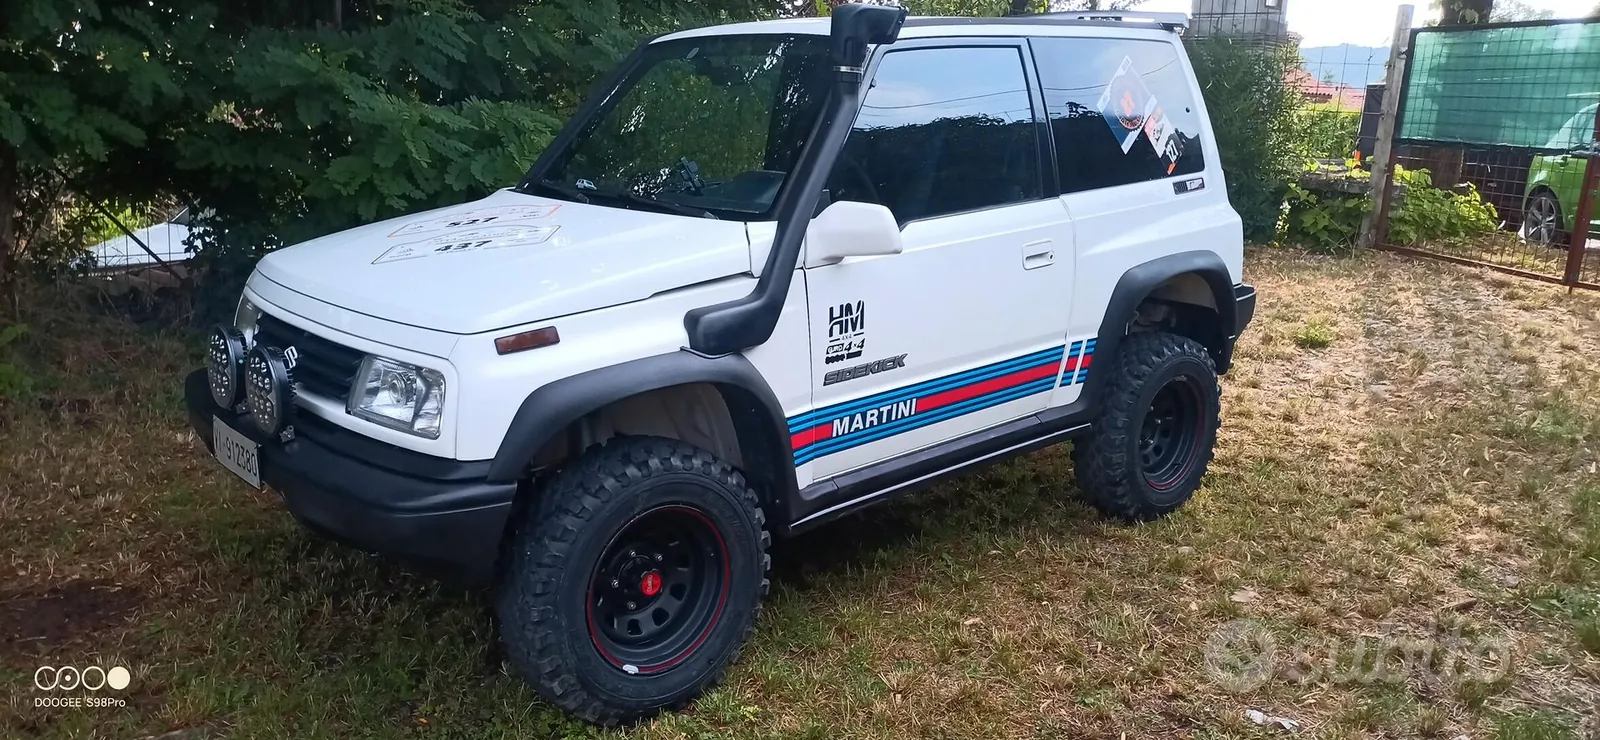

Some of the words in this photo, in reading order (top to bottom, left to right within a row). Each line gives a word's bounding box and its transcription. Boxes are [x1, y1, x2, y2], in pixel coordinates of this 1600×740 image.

[434, 239, 493, 252] 437
[828, 300, 865, 338] HM
[823, 353, 908, 386] SIDEKICK
[832, 398, 917, 437] MARTINI
